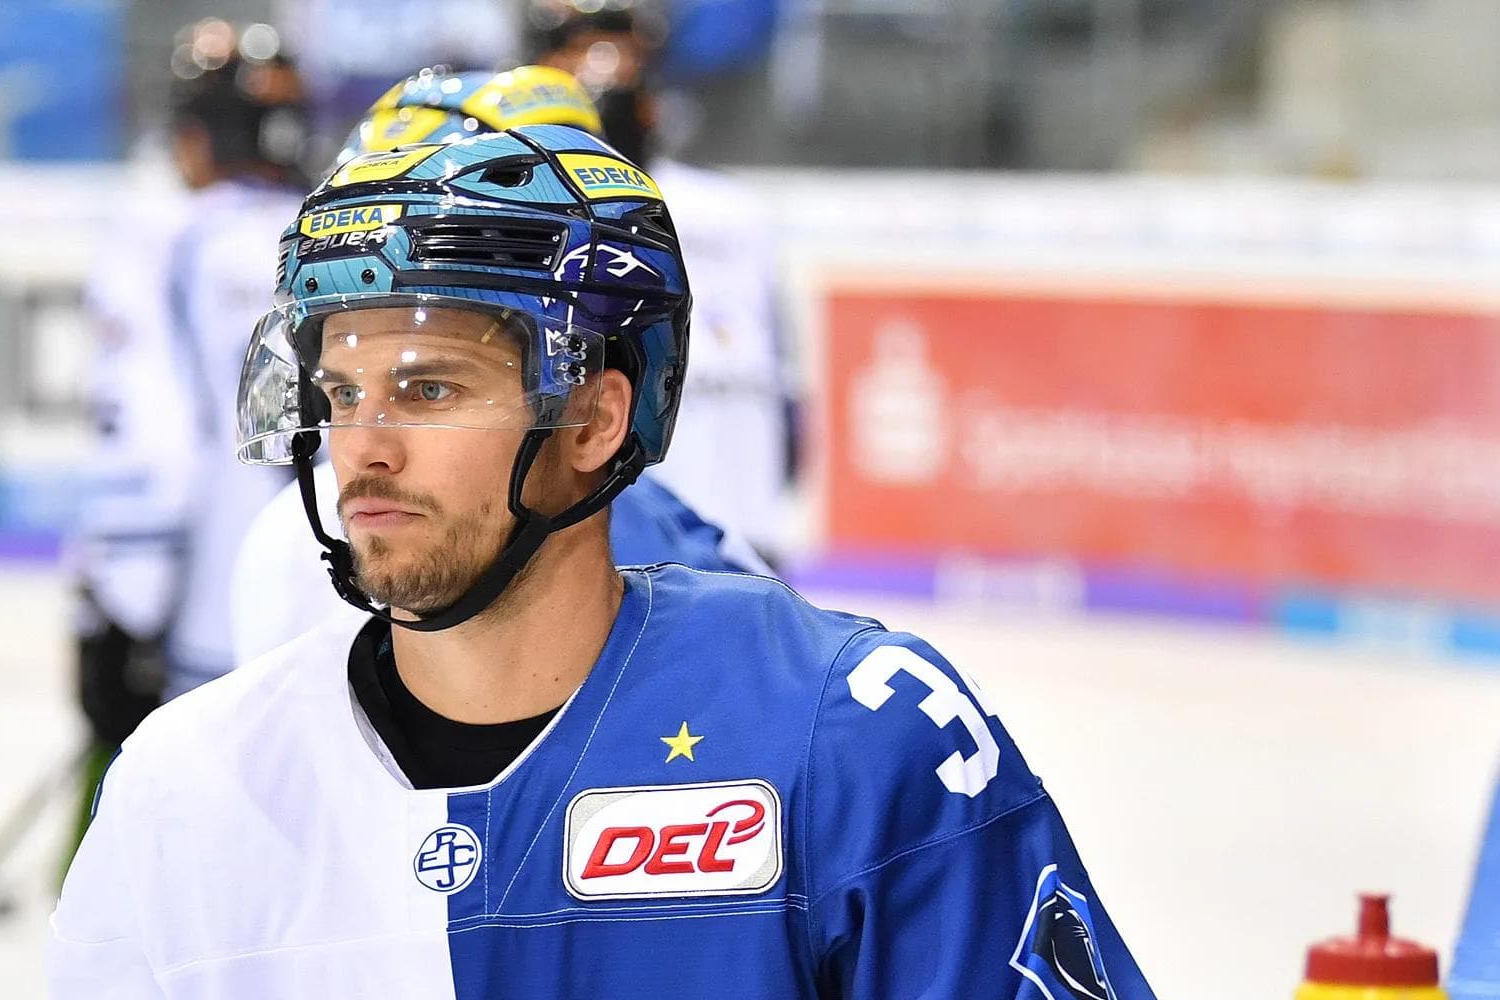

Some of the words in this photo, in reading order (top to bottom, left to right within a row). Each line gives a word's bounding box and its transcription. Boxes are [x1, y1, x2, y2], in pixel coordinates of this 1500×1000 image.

[573, 167, 650, 188] EDEKA
[310, 207, 383, 233] EDEKA
[846, 645, 1000, 798] 3
